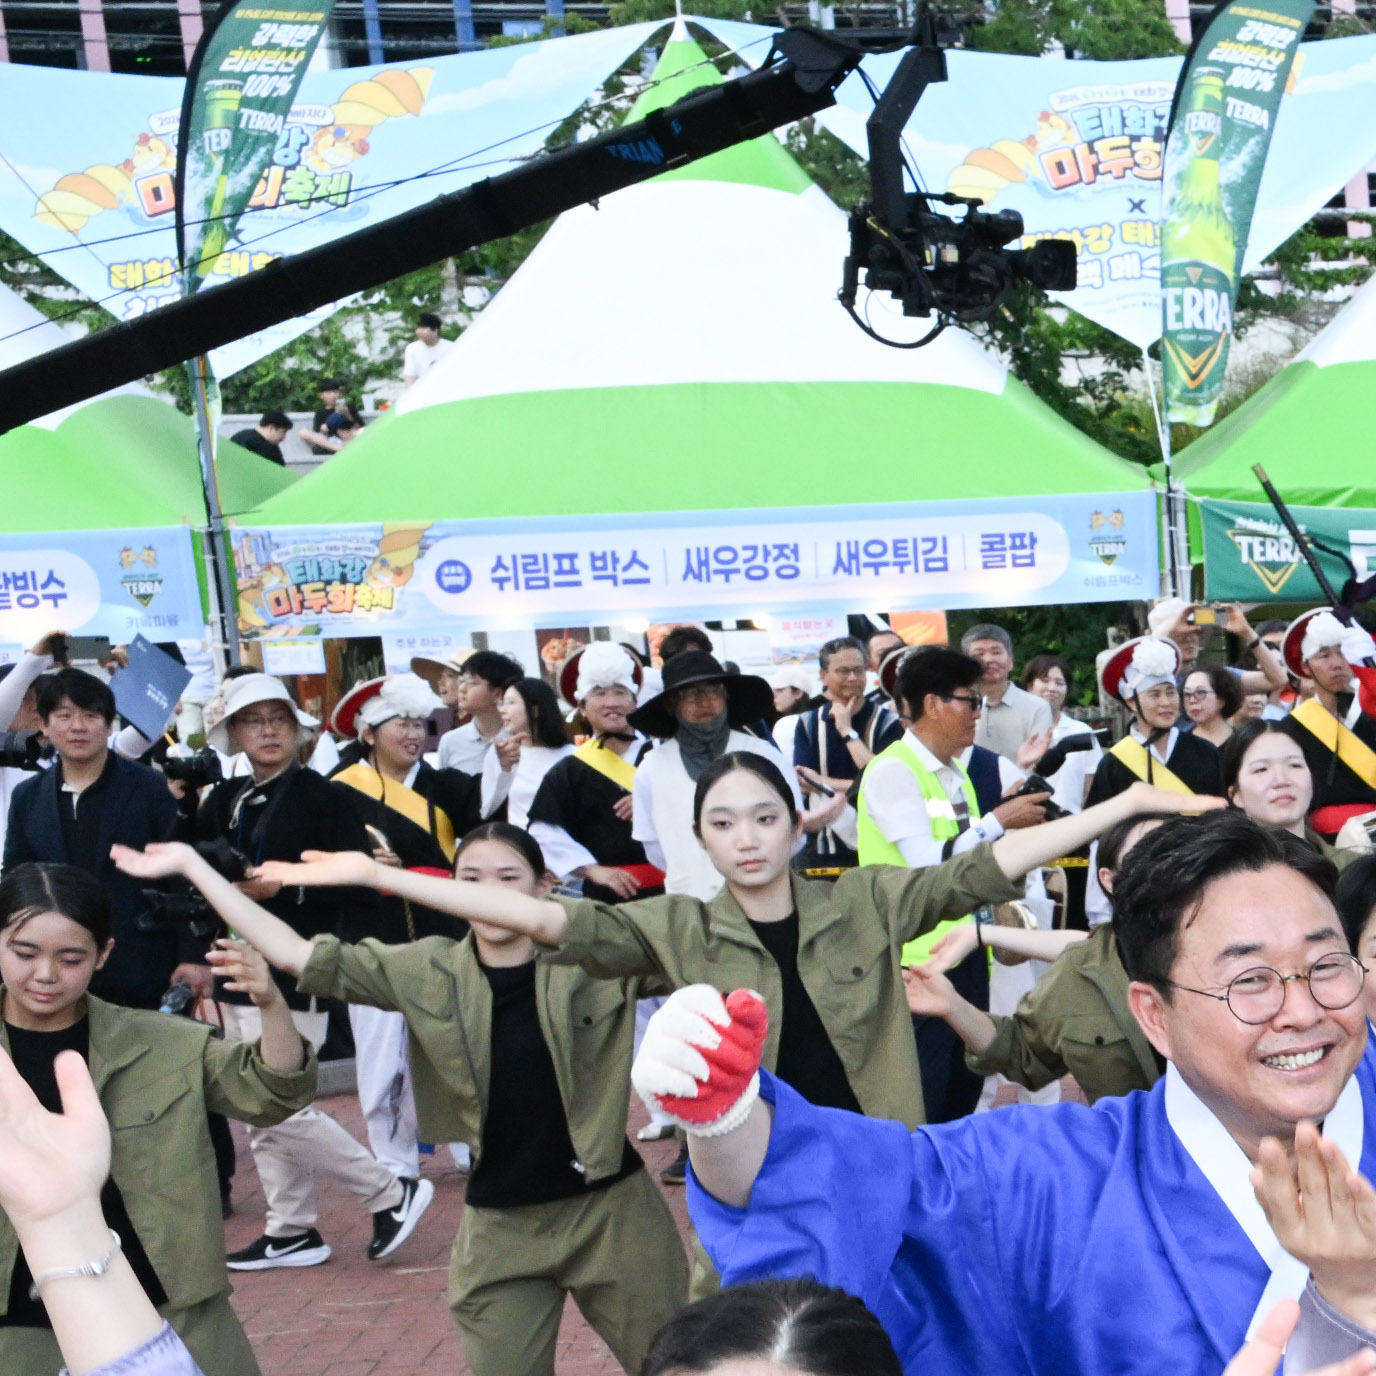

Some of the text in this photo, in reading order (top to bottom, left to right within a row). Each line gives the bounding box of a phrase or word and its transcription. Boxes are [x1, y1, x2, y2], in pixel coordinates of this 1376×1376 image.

[242, 74, 296, 98] 100%
[1225, 66, 1278, 92] 100%
[240, 108, 286, 136] TERRA
[1226, 96, 1270, 131] TERRA
[1040, 136, 1165, 190] 마두희
[288, 556, 366, 585] 태화강
[489, 530, 1038, 591] 쉬림프 박스 새우강정 새우튀김 콜팝
[123, 579, 163, 596] TERRA
[268, 580, 395, 618] 마두희축제
